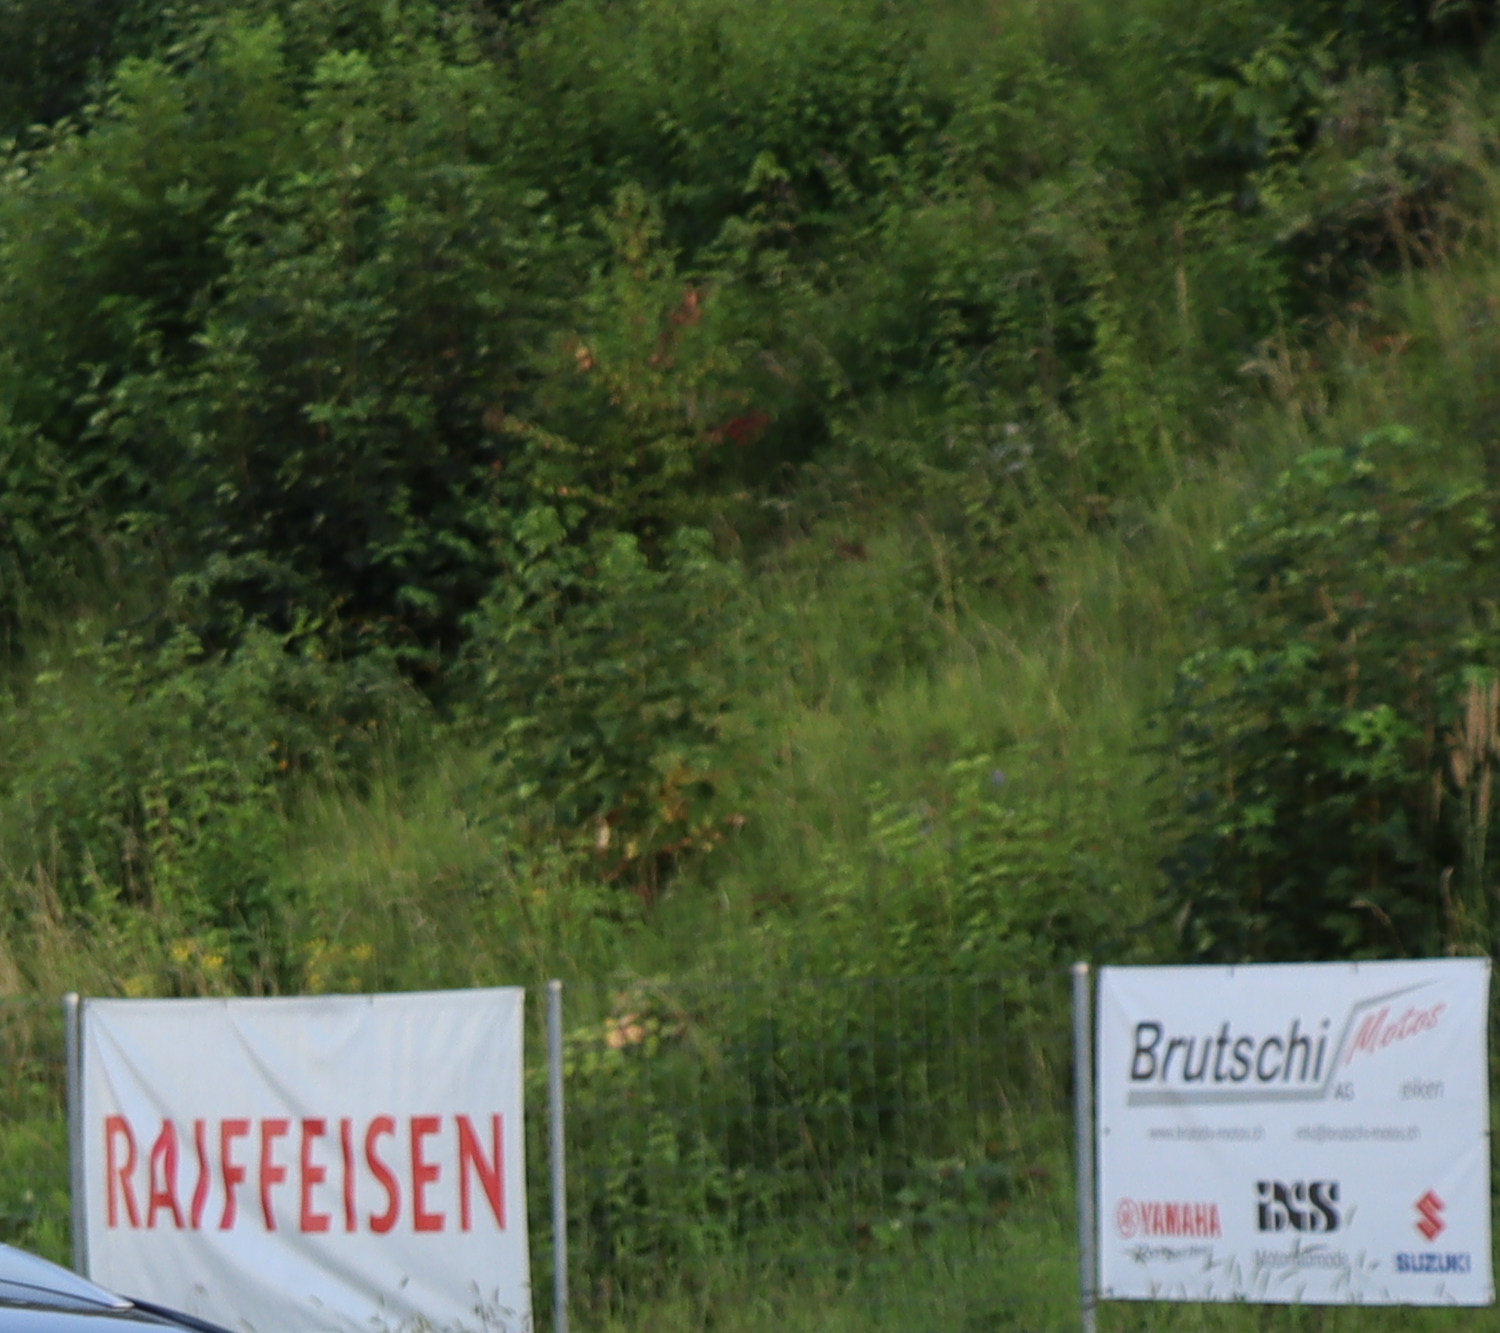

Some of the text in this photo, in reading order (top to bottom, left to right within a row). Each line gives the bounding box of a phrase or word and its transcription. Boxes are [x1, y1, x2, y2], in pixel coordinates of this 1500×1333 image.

[1129, 1018, 1331, 1083] Brutschi
[1343, 1001, 1448, 1067] Motos
[105, 1113, 507, 1233] RAIFFEISEN
[1140, 1203, 1222, 1238] YAMAHA
[1396, 1252, 1471, 1273] SUZUKI
